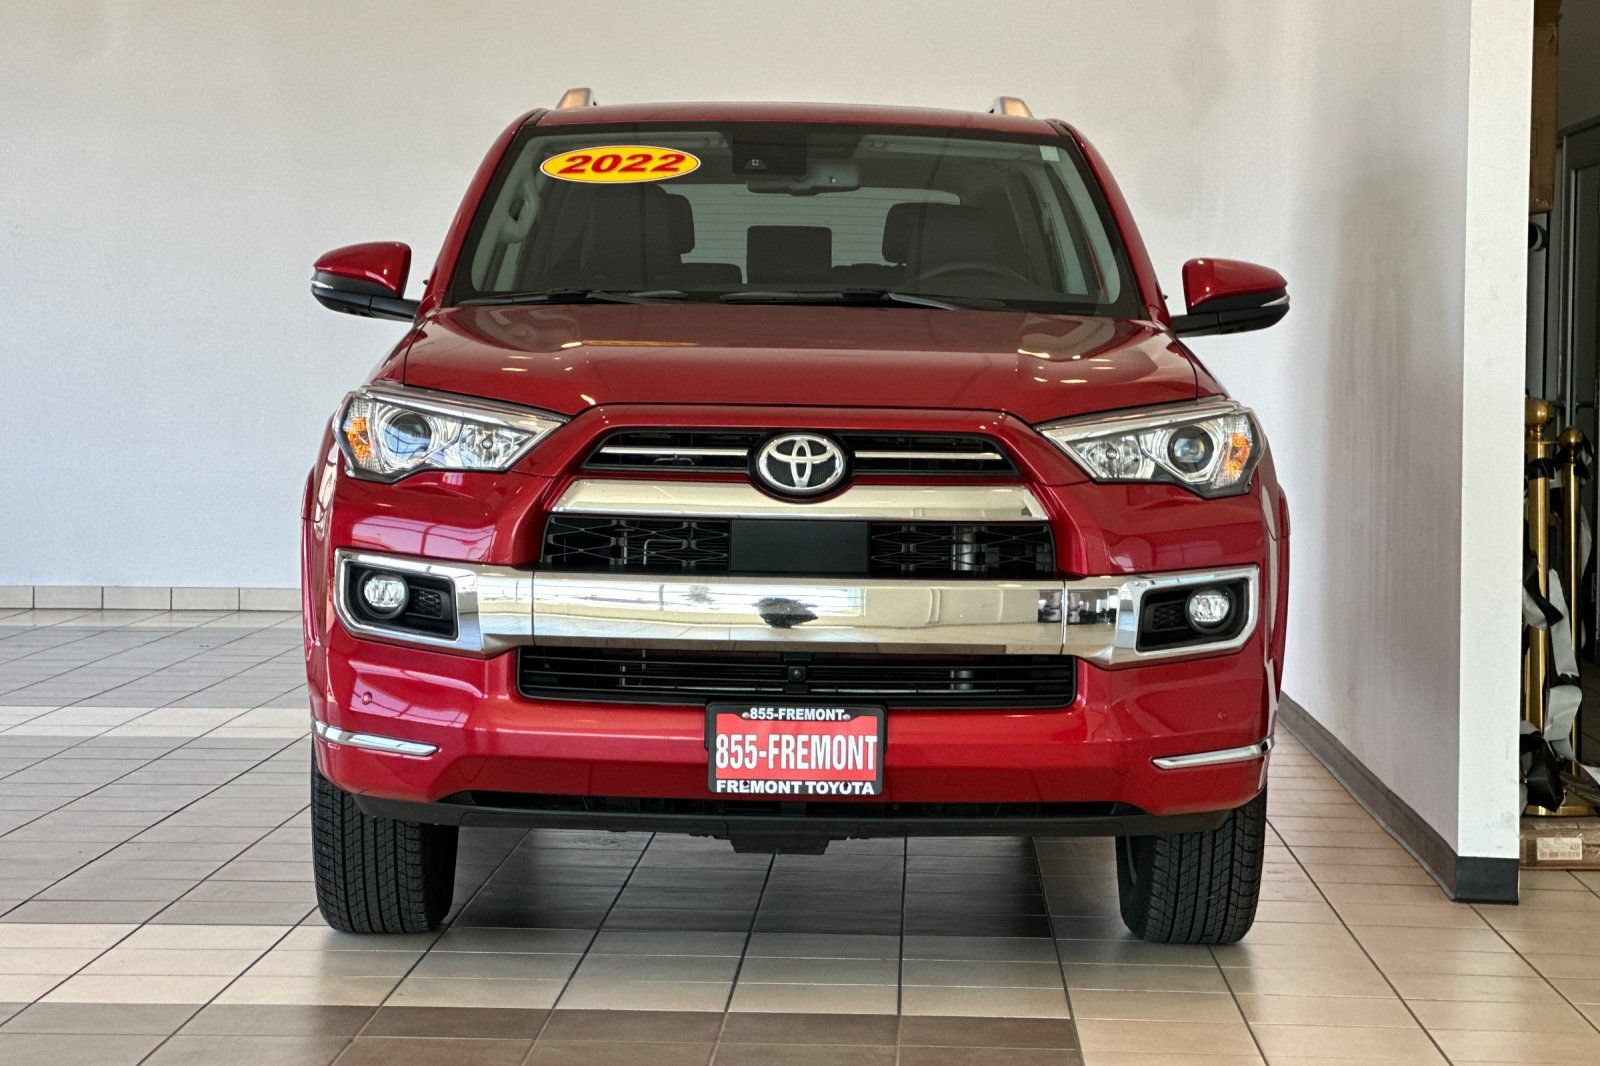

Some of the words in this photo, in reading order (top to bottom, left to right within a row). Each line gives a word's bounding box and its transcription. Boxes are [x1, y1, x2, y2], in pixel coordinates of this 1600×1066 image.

[557, 153, 687, 175] 2022
[750, 707, 845, 721] 855-FREMONT
[715, 733, 878, 771] 855-FREMONT
[716, 780, 803, 794] FREMONT
[804, 781, 875, 795] TOYOTA
